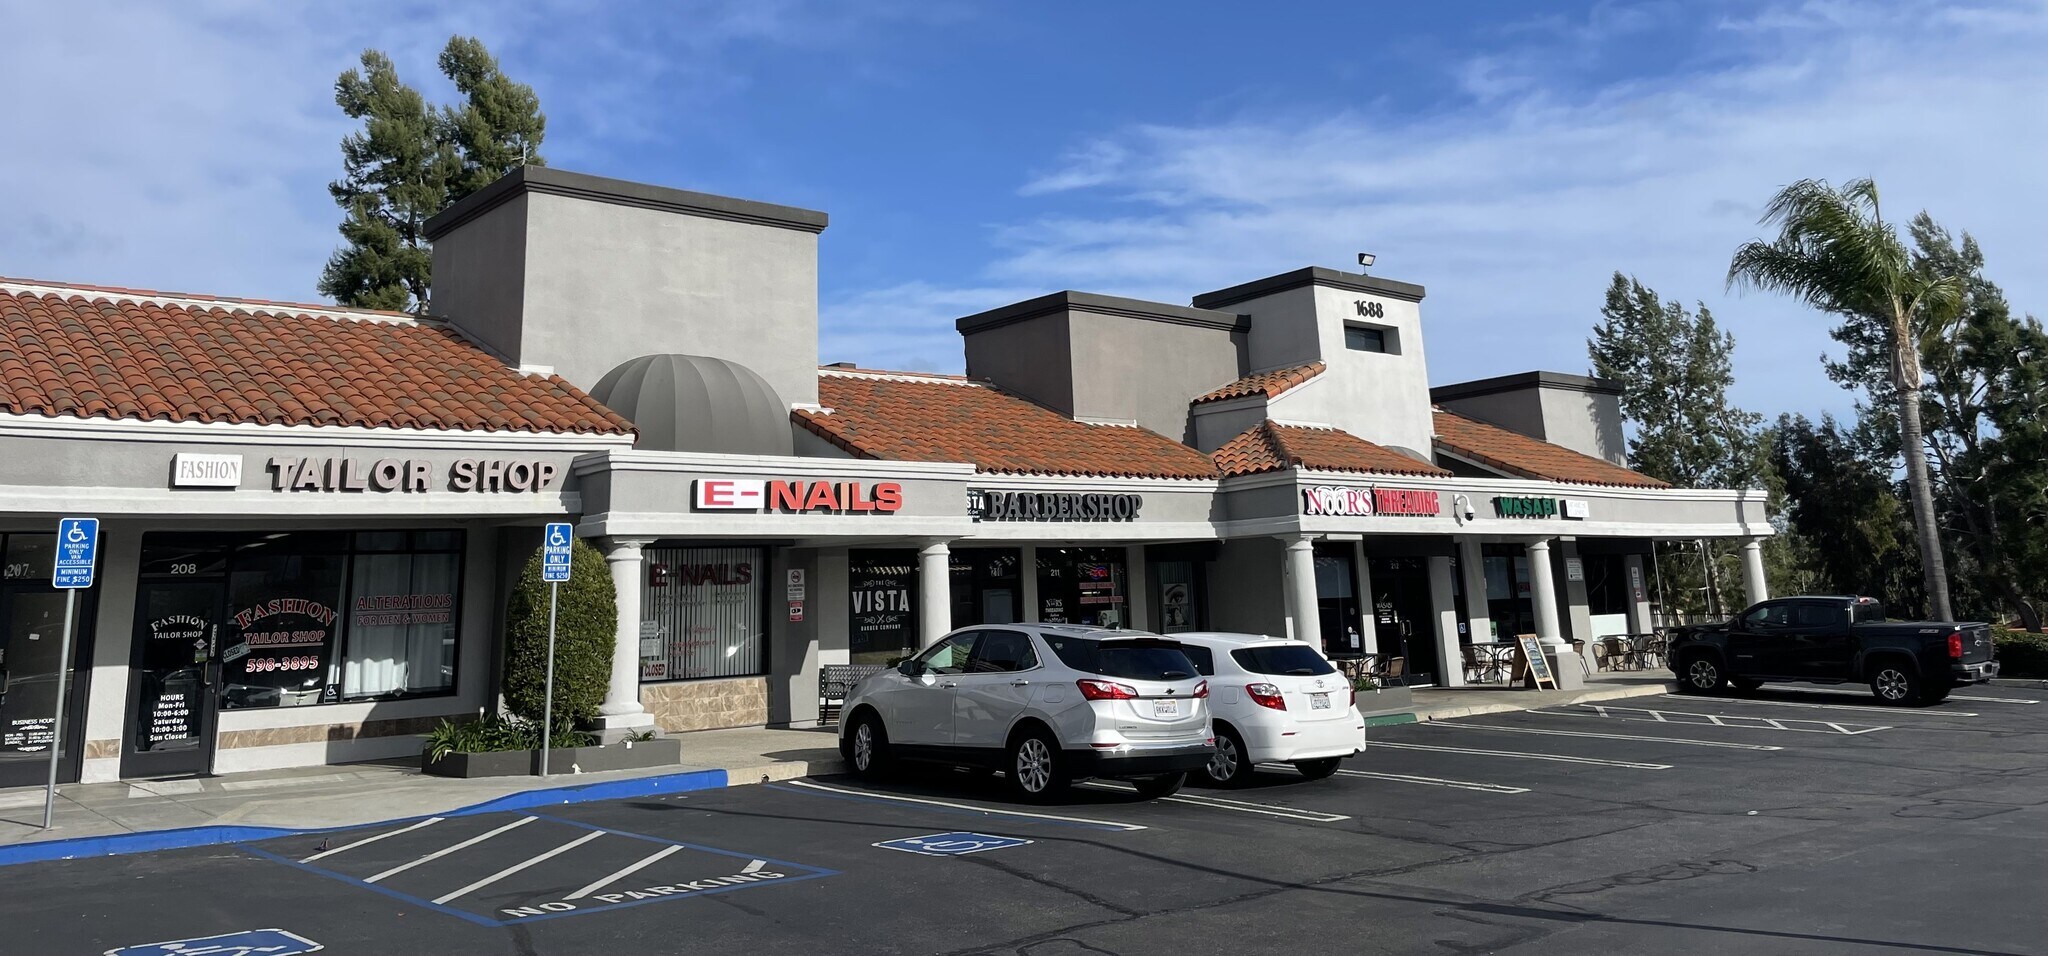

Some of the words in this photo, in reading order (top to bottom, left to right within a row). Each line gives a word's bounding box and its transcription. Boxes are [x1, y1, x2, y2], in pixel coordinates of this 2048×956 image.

[1353, 299, 1384, 319] 1688
[180, 460, 239, 480] FASHION
[271, 457, 432, 491] TAILOR
[452, 458, 558, 491] SHOP
[988, 491, 1143, 519] BARBERSHOP
[1374, 488, 1440, 514] THREADING
[1499, 497, 1558, 515] WASABI
[545, 545, 570, 555] PARKING
[550, 555, 565, 563] ONLY
[170, 563, 197, 574] 208
[1050, 569, 1060, 577] 211
[72, 575, 90, 583] $250
[356, 593, 453, 611] ALTERATIONS
[852, 590, 910, 614] VISTA
[234, 598, 339, 630] FASHION
[357, 615, 377, 626] FOR
[378, 614, 400, 625] MEN
[402, 613, 411, 624] &
[411, 612, 450, 623] WOMEN
[150, 615, 208, 632] FASHION
[153, 631, 181, 639] TAILOR
[243, 632, 289, 645] TAILOR
[291, 630, 326, 642] SHOP
[245, 655, 319, 673] 598-3895
[644, 663, 665, 676] CLOSED
[153, 709, 189, 717] 10:00-6:00
[151, 725, 188, 733] 10:00-3:00
[153, 718, 185, 726] Saturday
[501, 902, 576, 917] NO
[593, 871, 785, 903] PARKING
